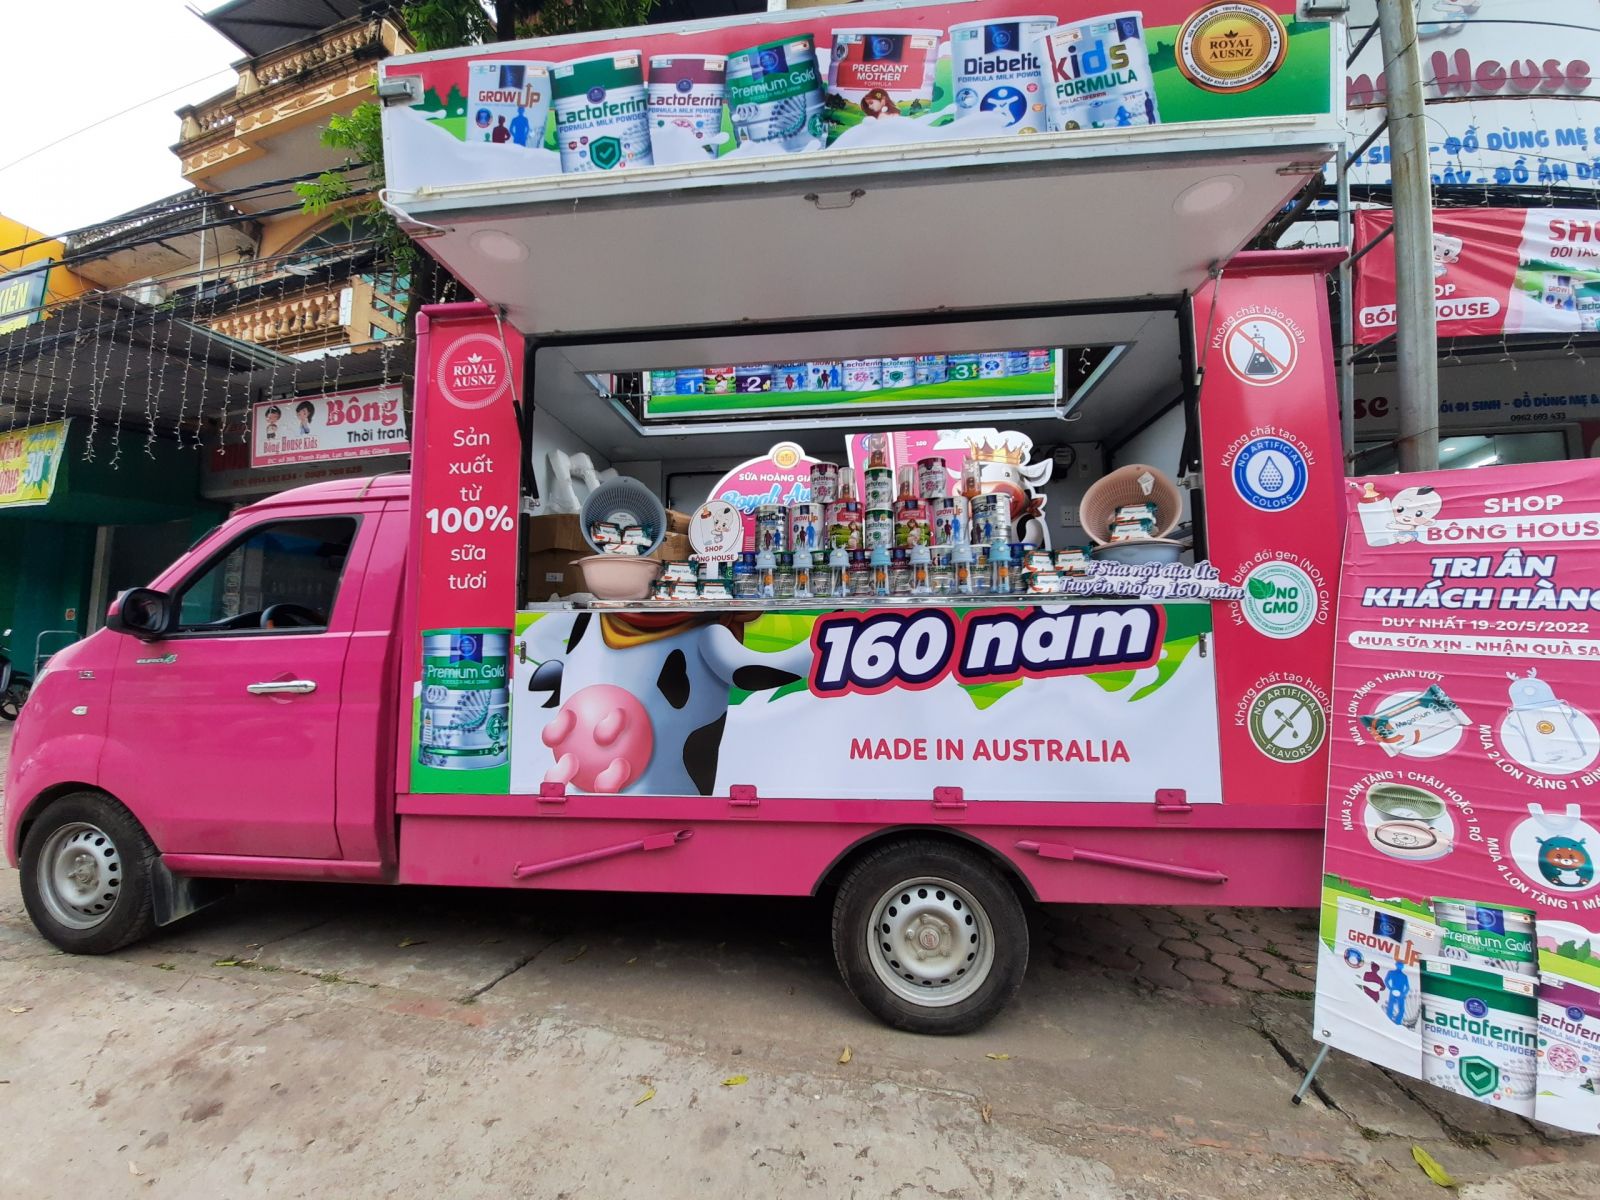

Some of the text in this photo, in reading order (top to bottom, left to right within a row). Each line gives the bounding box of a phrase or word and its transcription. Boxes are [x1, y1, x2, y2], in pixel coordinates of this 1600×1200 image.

[1209, 38, 1254, 49] ROYAL
[1209, 48, 1254, 59] AUSNZ
[852, 63, 908, 73] PREGNANT
[964, 53, 1041, 75] Diabetic
[1045, 39, 1129, 83] kids
[857, 72, 901, 81] MOTHER
[1430, 48, 1592, 96] House
[732, 78, 788, 99] Premium
[789, 68, 816, 84] Gold
[1056, 69, 1138, 98] FORMULA
[478, 83, 541, 108] GROW UP
[647, 93, 722, 106] Lactoferrin
[556, 96, 648, 125] Lactoferrin
[559, 122, 594, 133] FORMULA
[596, 118, 615, 127] MILK
[616, 111, 648, 124] POWDER
[1486, 126, 1550, 151] DÙNG
[1555, 127, 1588, 151] MẸ
[1436, 302, 1490, 318] OUSE
[1212, 304, 1306, 349] Không chất bảo quản
[453, 363, 497, 376] ROYAL
[955, 364, 970, 379] 3
[453, 374, 496, 388] AUSNZ
[747, 376, 761, 392] 2
[326, 396, 399, 427] Bông
[281, 436, 303, 452] House
[303, 436, 318, 450] Kids
[347, 428, 374, 444] Thời
[453, 427, 490, 447] Sản
[1220, 424, 1316, 467] Không chất tạo màu
[449, 453, 493, 475] xuất
[1237, 440, 1300, 468] NO ARTIFICIAL
[739, 471, 757, 481] SỮA
[759, 473, 794, 482] HOÀNG
[460, 485, 482, 501] từ
[1252, 494, 1294, 508] COLORS
[1484, 494, 1564, 514] SHOP
[425, 505, 514, 534] 100%
[1426, 522, 1507, 541] BÔNG
[450, 544, 486, 561] sữa
[704, 545, 724, 553] SHOP
[711, 554, 735, 562] HOUSE
[1431, 547, 1557, 579] TRI ÂN
[448, 570, 487, 590] tươi
[1275, 550, 1298, 563] gen
[1299, 558, 1326, 588] (NON
[1315, 590, 1330, 625] GMO)
[1166, 581, 1200, 599] 160
[1200, 584, 1245, 600] năm
[1276, 587, 1298, 600] NO
[1361, 579, 1495, 609] KHÁCH
[1262, 601, 1299, 614] GMO
[1381, 615, 1590, 634] DUY NHẤT 19-20/5/2022
[818, 604, 1153, 686] 160 năm
[1358, 635, 1572, 656] MUA SỮA XỊN NHẬN QUÀ
[427, 664, 505, 679] Premium Gold
[1383, 670, 1416, 681] KHĂN
[1418, 670, 1445, 682] ƯỚT
[1235, 671, 1333, 726] Không chất tạo hương
[1354, 680, 1376, 700] TẶNG
[1253, 688, 1320, 715] NO ARTIFICIAL
[1347, 700, 1359, 718] LON
[1349, 726, 1366, 747] MUA
[850, 737, 1131, 763] MADE IN AUSTRALIA
[1265, 743, 1314, 758] FLAVORS
[1479, 724, 1580, 791] MUA 2 LON TẶNG 1
[1342, 808, 1354, 831] MUA
[1349, 782, 1365, 801] LON
[1361, 771, 1394, 786] TẶNG
[1397, 770, 1403, 779] 1
[1407, 771, 1445, 790] CHẬU
[1444, 787, 1474, 815] HOẶC
[1487, 837, 1502, 863] MUA
[1503, 872, 1530, 894] LON
[1530, 889, 1568, 910] TẶNG
[1571, 901, 1579, 910] 1
[1348, 929, 1394, 954] GROW
[1442, 927, 1502, 949] Premium
[1505, 938, 1532, 953] Gold
[1421, 1003, 1538, 1048] Lactoferrin
[1424, 1023, 1536, 1058] FORMULA MILK POWDER
